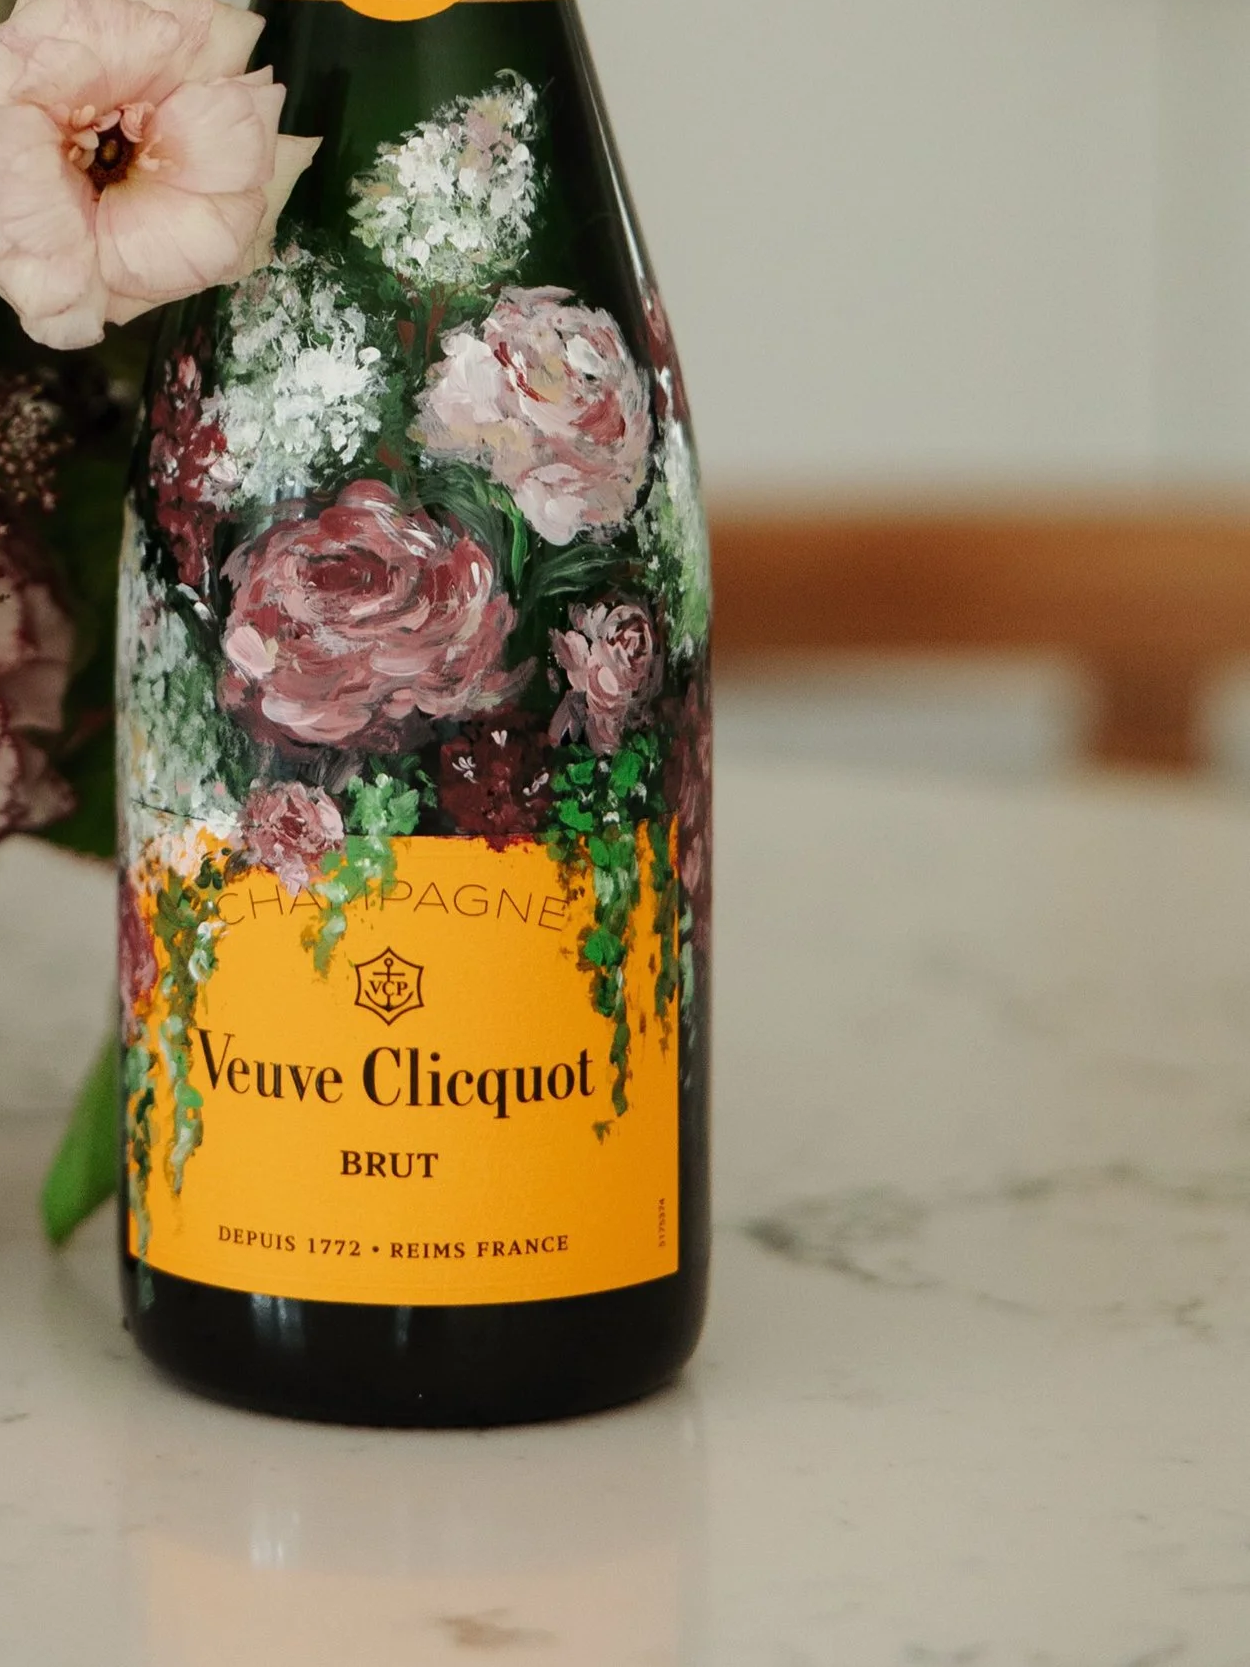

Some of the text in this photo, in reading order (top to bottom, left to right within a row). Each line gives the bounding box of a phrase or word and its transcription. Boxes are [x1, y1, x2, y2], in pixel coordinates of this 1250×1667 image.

[368, 979, 409, 997] VCP
[194, 1027, 596, 1120] Veuve Clicquot
[339, 1149, 440, 1179] BRUT
[218, 1224, 569, 1259] DEPUIS 1772 REIMS FRANCE
